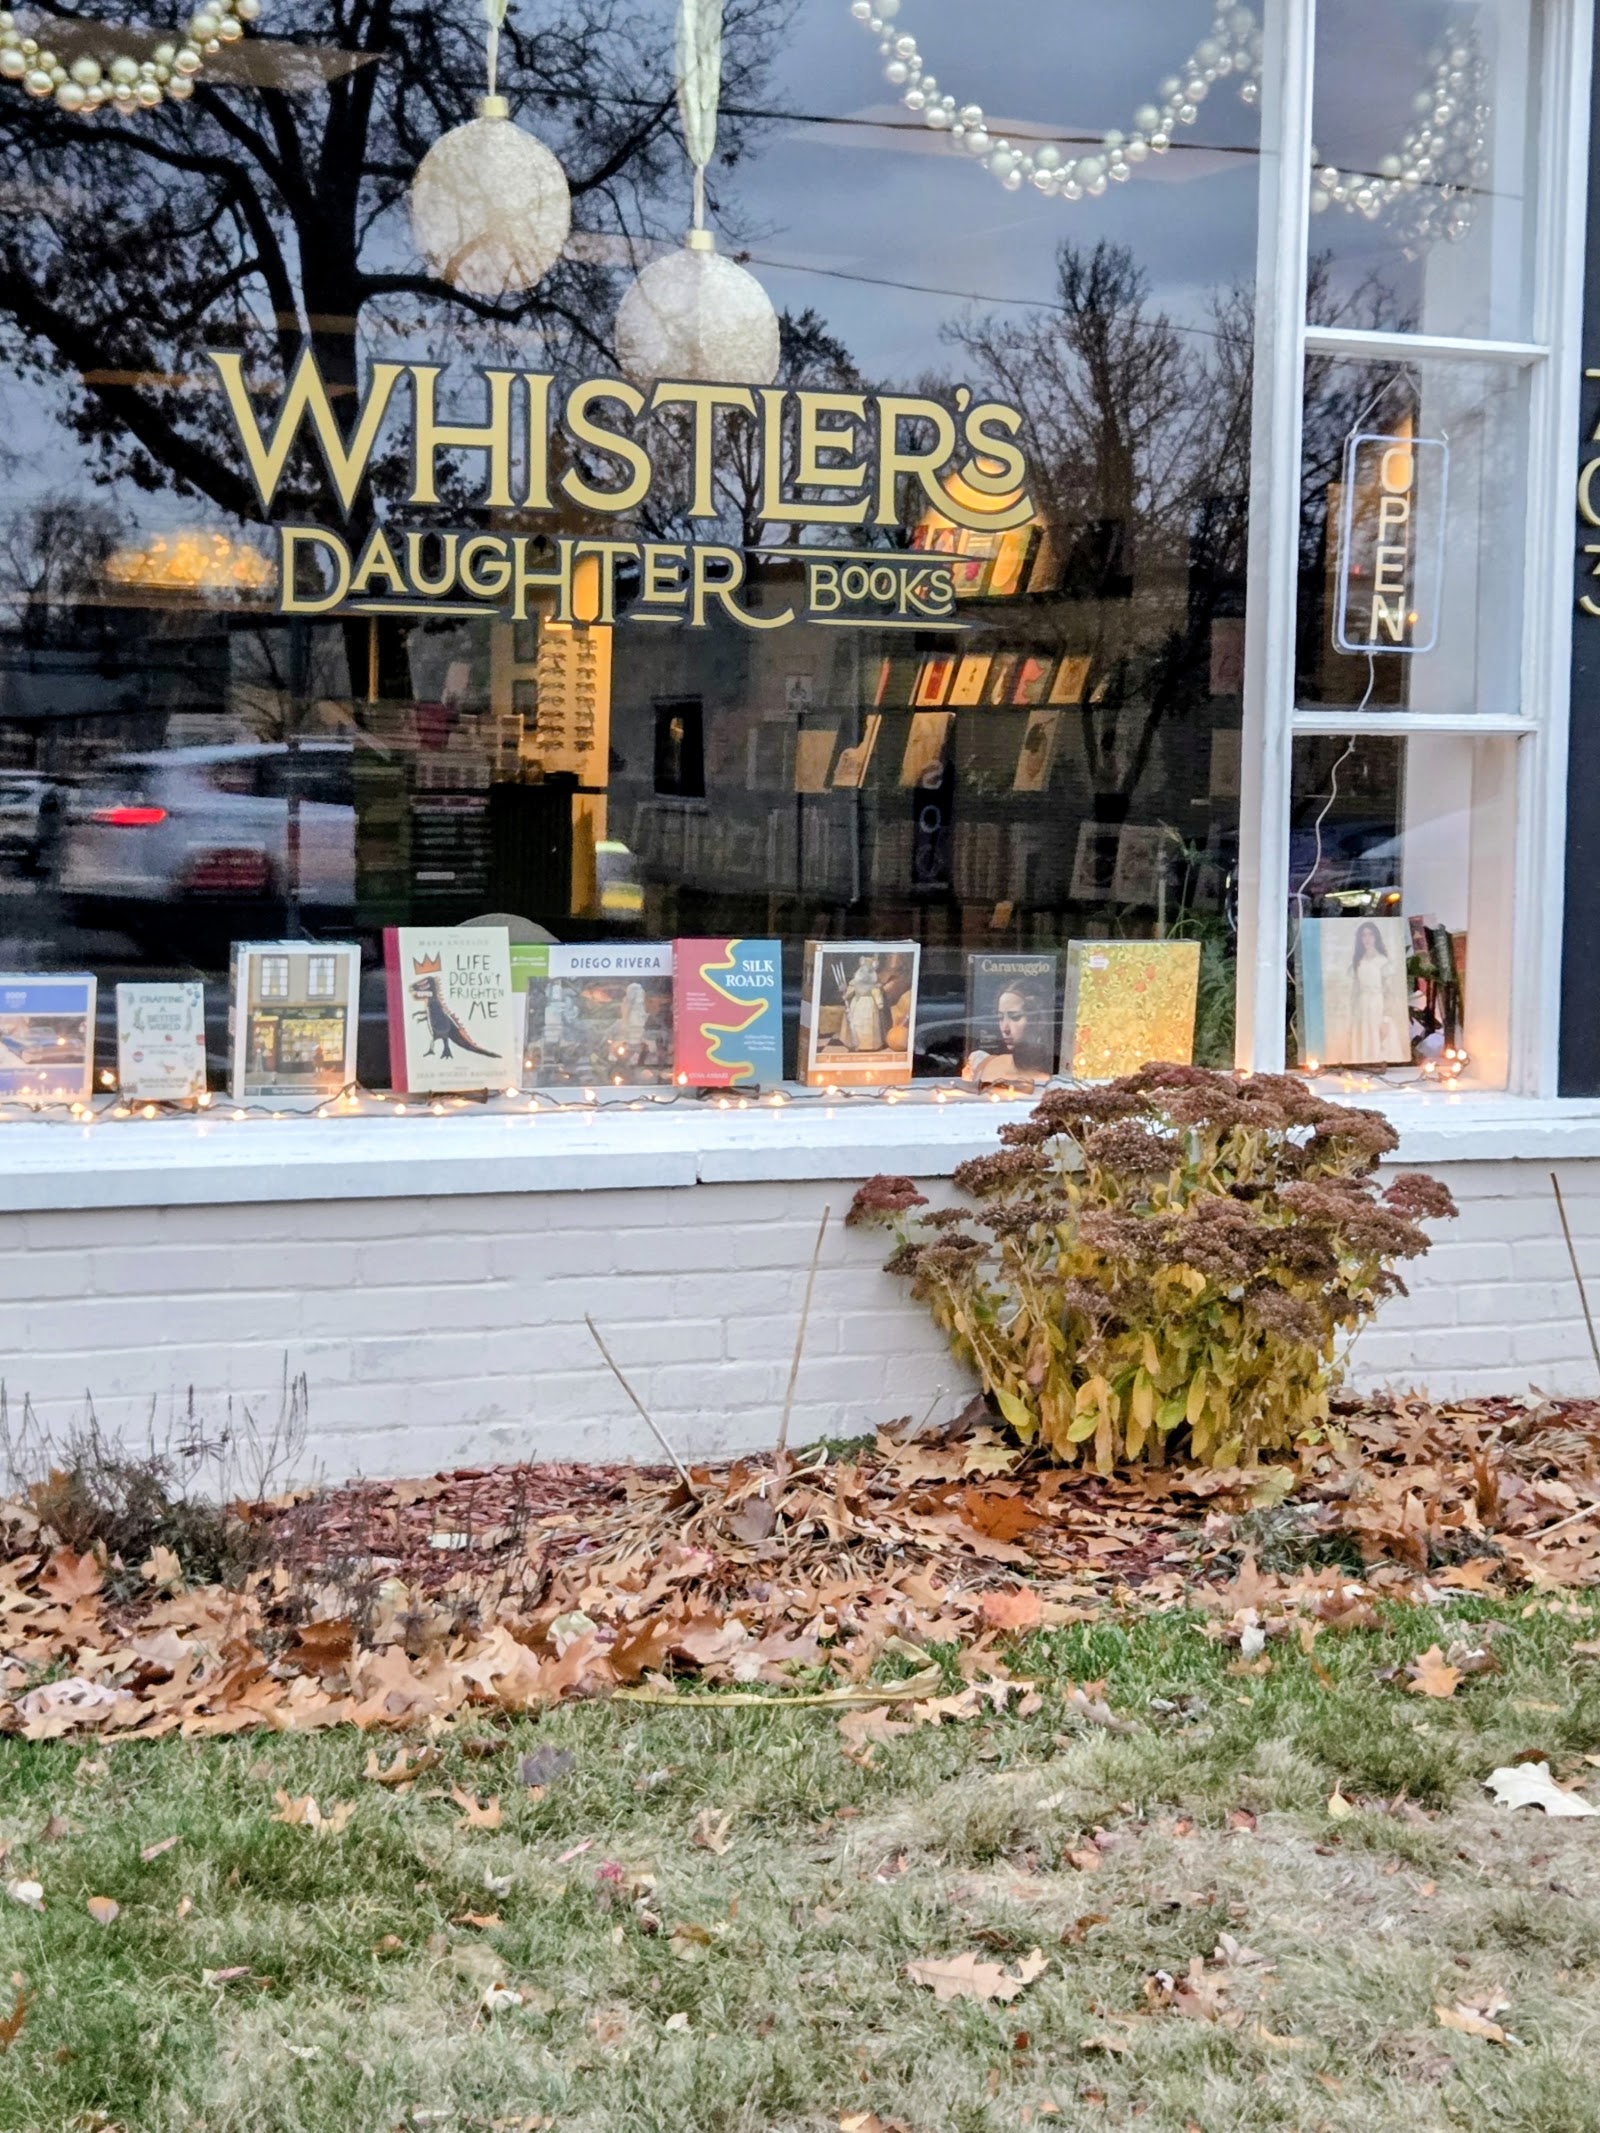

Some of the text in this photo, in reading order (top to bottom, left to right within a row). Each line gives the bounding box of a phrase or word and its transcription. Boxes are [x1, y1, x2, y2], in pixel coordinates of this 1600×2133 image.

[206, 345, 1036, 531] WHISTLER'S
[1369, 446, 1415, 642] OPEN
[279, 525, 953, 629] DAUGHTER BOOKS
[456, 954, 491, 971] LIFE
[570, 956, 661, 969] DIEGO RIVERA
[742, 959, 775, 973] SILK
[981, 958, 1050, 976] Caravaggio
[725, 974, 775, 987] ROADS
[449, 987, 505, 1000] FRIGHTEN
[468, 1001, 500, 1021] ME
